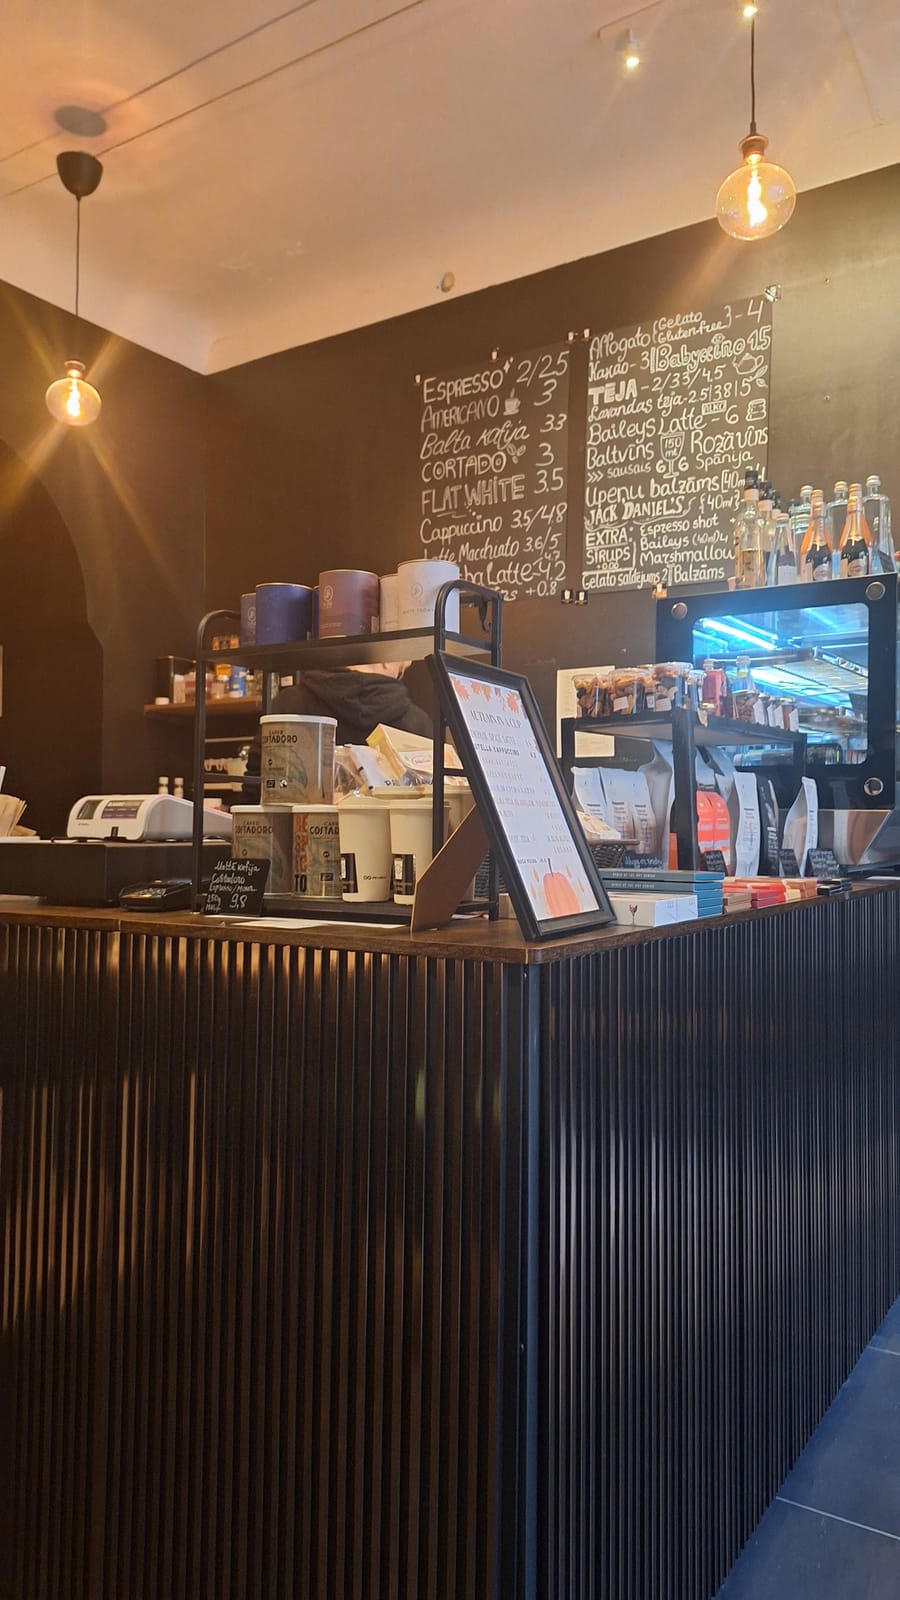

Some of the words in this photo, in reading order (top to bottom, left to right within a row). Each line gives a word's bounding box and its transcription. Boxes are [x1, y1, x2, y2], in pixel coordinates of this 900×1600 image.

[658, 312, 702, 330] Gelato
[589, 327, 651, 362] Affogato
[424, 370, 504, 404] ESPRESSO
[421, 395, 500, 432] AMERICANO
[533, 379, 557, 406] 3
[588, 418, 656, 446] Baileys
[658, 407, 707, 436] Latte
[725, 404, 739, 424] 6
[420, 429, 471, 459] Balta
[422, 451, 506, 482] CORTADO
[535, 443, 554, 467] 3
[607, 462, 651, 479] sausais
[656, 459, 666, 473] 6
[679, 456, 689, 471] 6
[422, 485, 462, 515] FLAT
[465, 474, 525, 506] WHITE
[533, 467, 564, 494] 3.5
[588, 506, 618, 526] JACK
[622, 495, 685, 520] DANIEL'S
[420, 516, 502, 544] Cappuccino
[640, 519, 690, 538] Espresso
[692, 513, 720, 529] shot
[640, 533, 690, 551] Baileys
[486, 562, 534, 585] Latte
[582, 572, 617, 590] Gelato
[310, 825, 339, 835] COSTAD
